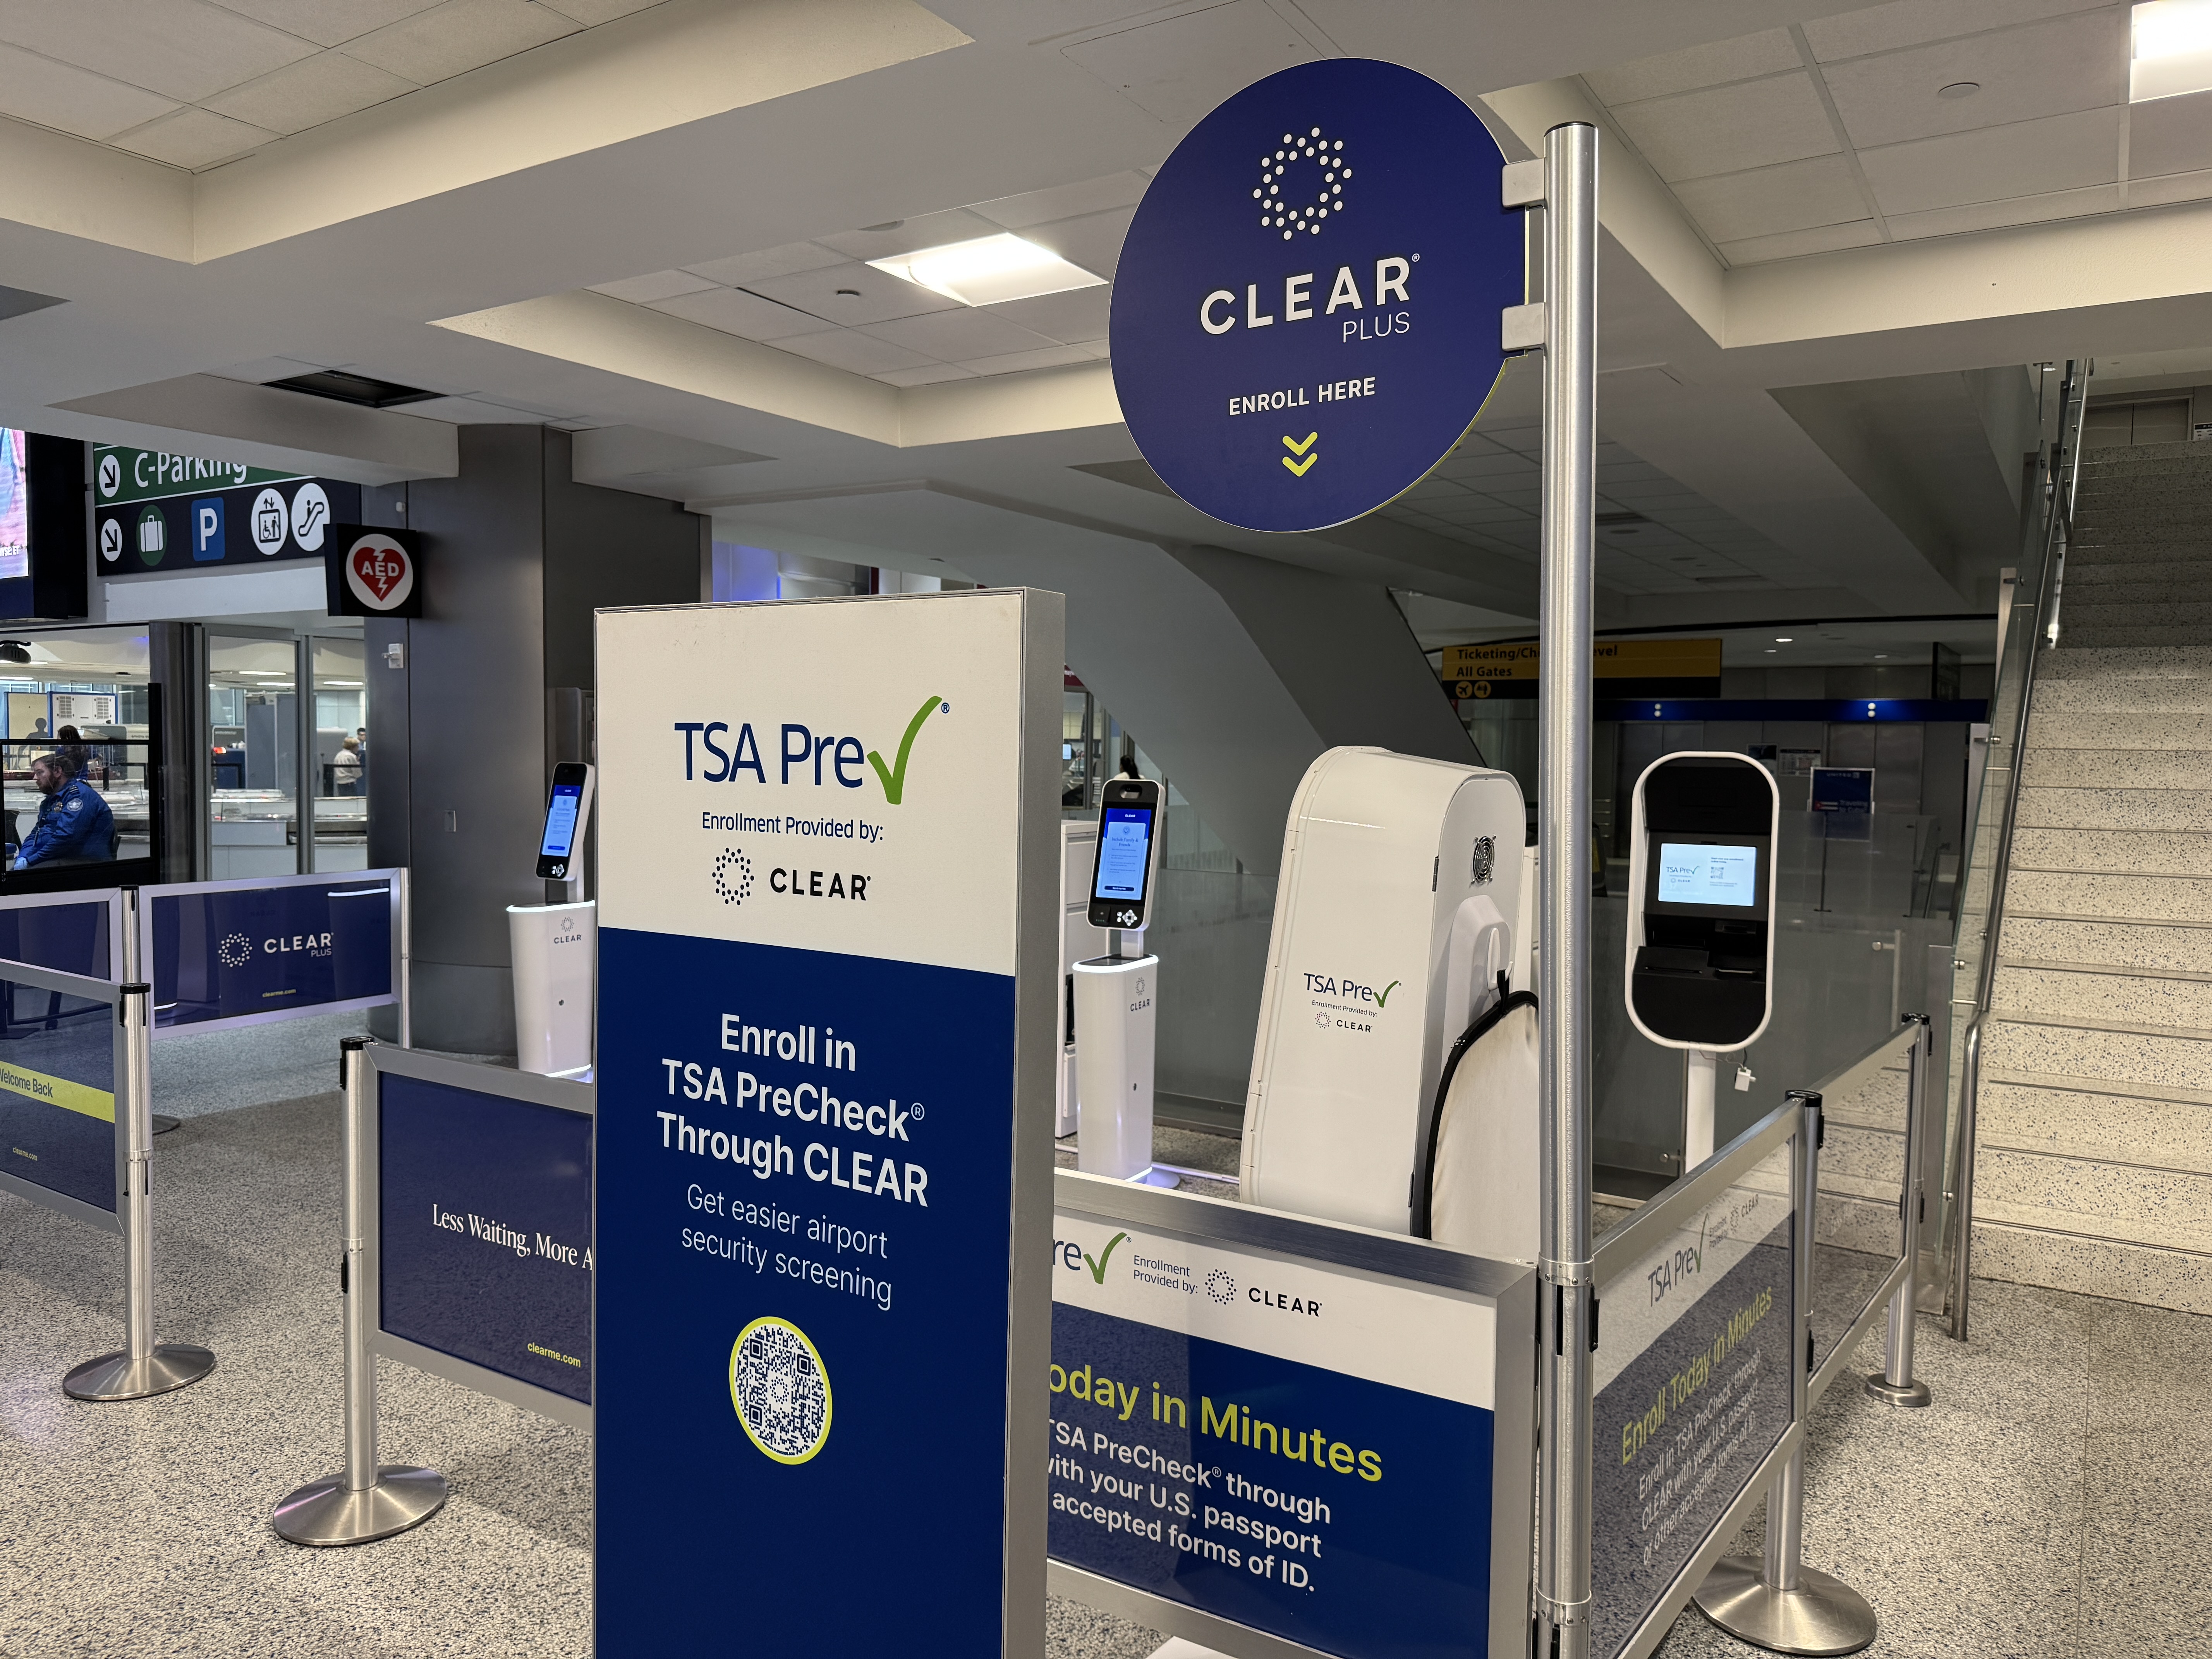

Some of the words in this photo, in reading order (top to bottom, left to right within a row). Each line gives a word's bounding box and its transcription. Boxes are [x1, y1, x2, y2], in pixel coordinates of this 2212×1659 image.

[1343, 312, 1410, 343] PLUS
[1229, 388, 1309, 416] ENROLL
[1318, 377, 1376, 403] HERE
[361, 562, 399, 577] AED
[1458, 647, 1539, 661] Ticketing/Ch
[1594, 644, 1617, 656] vel
[1457, 666, 1472, 677] All
[1477, 666, 1512, 677] Gates
[674, 722, 766, 784] TSA
[702, 811, 781, 835] Enrollment
[785, 816, 853, 838] Provided
[859, 820, 884, 843] by:
[311, 948, 332, 957] PLUS
[554, 934, 581, 944] CLEAR
[1304, 973, 1336, 995] TSA
[1130, 999, 1150, 1012] CLEAR
[1312, 1000, 1341, 1011] Enrollment
[1343, 1006, 1367, 1015] Provided
[721, 1013, 816, 1065] Enroll
[826, 1027, 855, 1071] in
[1336, 1020, 1372, 1033] CLEAR
[33, 1078, 53, 1097] Back
[662, 1058, 727, 1105] TSA
[13, 1147, 38, 1161] clearme.com
[657, 1111, 793, 1180] Through
[804, 1142, 928, 1207] CLEAR
[687, 1183, 725, 1217] Get
[732, 1197, 800, 1235] easier
[807, 1214, 888, 1259] airport
[1741, 1194, 1759, 1218] CLEAR
[433, 1204, 464, 1233] Less
[468, 1213, 531, 1257] Waiting,
[536, 1233, 578, 1266] More
[582, 1246, 593, 1270] A
[682, 1226, 768, 1274] security
[775, 1249, 892, 1311] screening
[1053, 1238, 1082, 1271] re
[1134, 1255, 1190, 1277] Enrollment
[1133, 1269, 1178, 1290] Provided
[1182, 1280, 1198, 1294] by:
[1648, 1260, 1672, 1307] TSA
[527, 1342, 581, 1367] clearme.com
[1623, 1386, 1666, 1466] Enroll
[1670, 1348, 1711, 1412] Today
[1714, 1332, 1725, 1367] in
[1728, 1286, 1772, 1352] Minutes
[1050, 1364, 1140, 1421] oday
[1152, 1381, 1186, 1428] in
[1201, 1395, 1383, 1481] Minutes
[1639, 1452, 1664, 1501] Enroll
[1666, 1446, 1674, 1469] in
[1676, 1421, 1693, 1456] TSA
[1735, 1347, 1760, 1389] through
[1642, 1479, 1673, 1531] CLEAR
[1674, 1457, 1692, 1494] with
[1694, 1435, 1712, 1475] your
[1728, 1378, 1759, 1433] passport
[1049, 1419, 1087, 1451] SA
[1226, 1472, 1331, 1524] through
[1644, 1539, 1652, 1565] or
[1655, 1509, 1678, 1550] other
[1680, 1456, 1717, 1519] accepted
[1719, 1434, 1739, 1472] forms
[1740, 1417, 1748, 1443] of
[1090, 1469, 1143, 1501] your
[1150, 1483, 1197, 1519] U.S.
[1204, 1504, 1321, 1558] passport
[1053, 1492, 1161, 1542] accepted
[1168, 1524, 1241, 1567] forms
[1248, 1554, 1275, 1579] of
[1282, 1559, 1315, 1592] ID.
